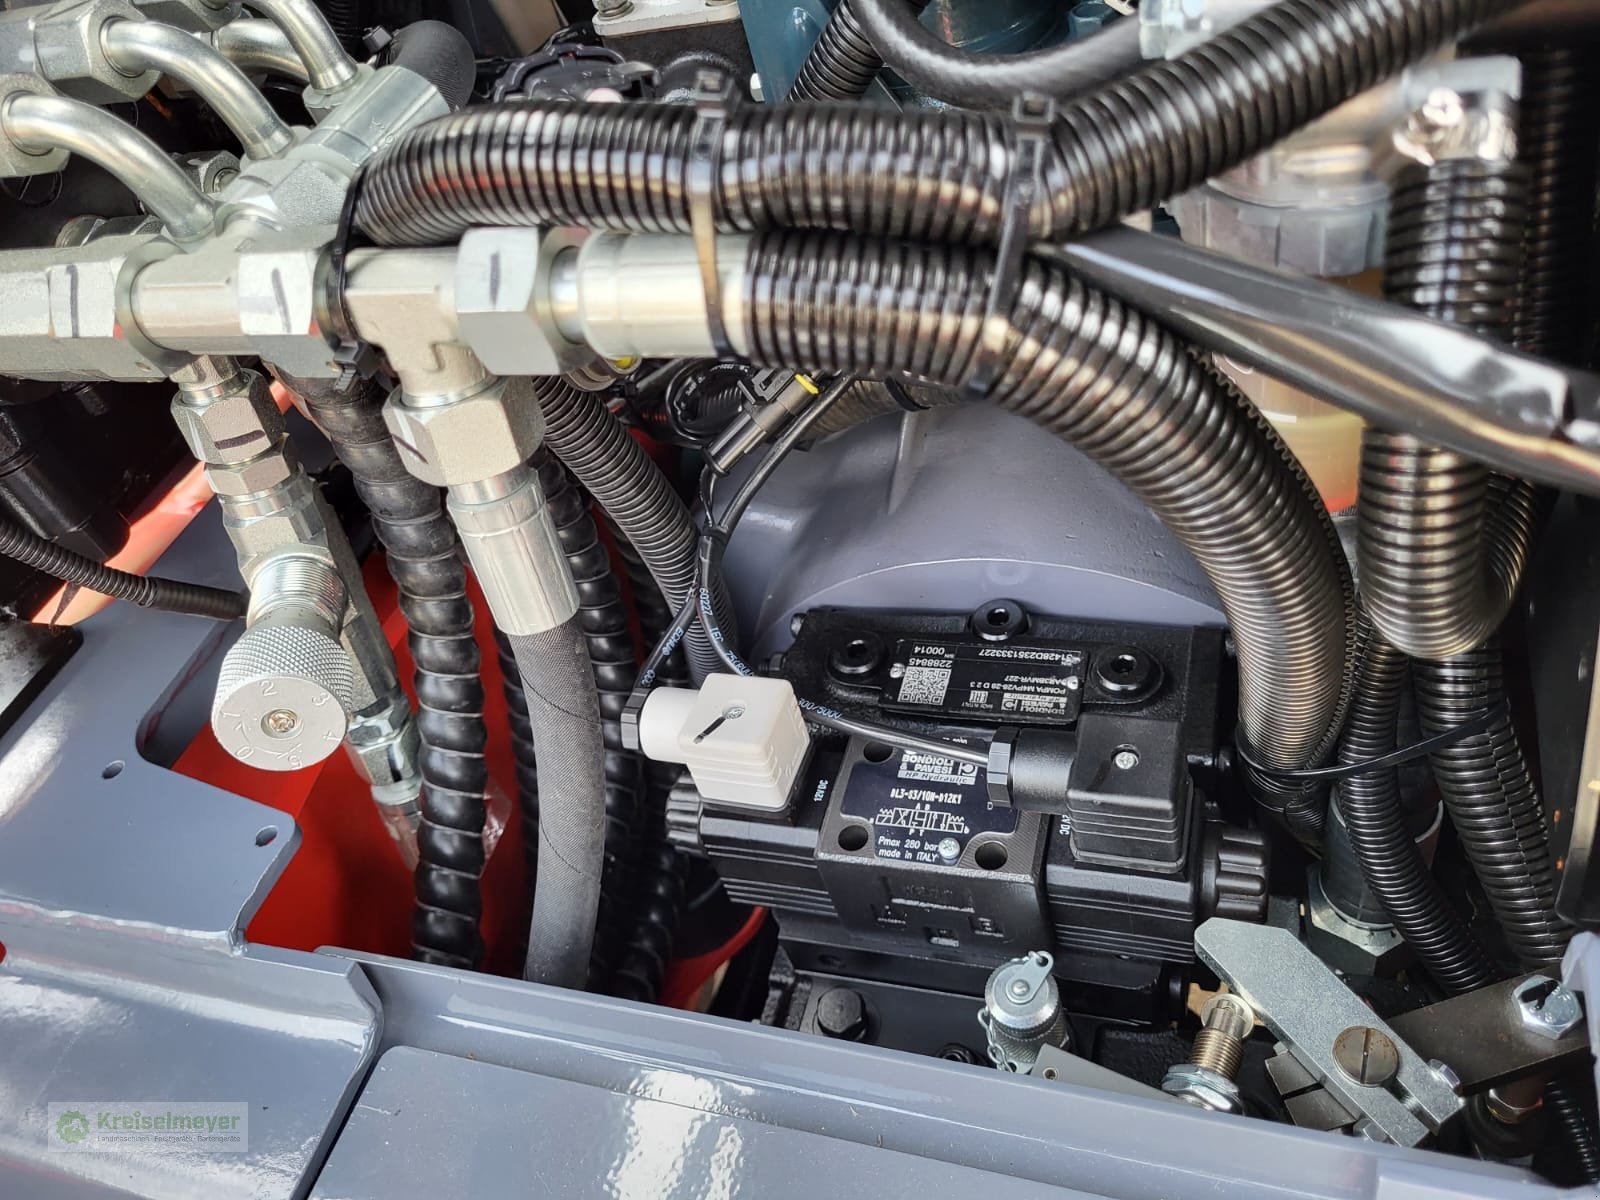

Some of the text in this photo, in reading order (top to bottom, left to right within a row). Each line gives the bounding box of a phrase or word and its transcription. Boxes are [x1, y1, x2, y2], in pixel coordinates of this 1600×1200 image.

[700, 588, 714, 616] 60227
[711, 627, 724, 642] IEC
[914, 646, 945, 654] 00014
[908, 658, 952, 668] 2288845
[260, 680, 278, 696] 2
[1036, 686, 1066, 694] POMPA
[312, 692, 330, 706] 3
[236, 746, 254, 760] 0
[902, 754, 954, 766] BONDIOLI
[914, 764, 952, 774] PAVESI
[922, 773, 968, 784] Hydraulic
[878, 836, 938, 851] Pmax 280 bar
[878, 848, 938, 862] made in ITALY
